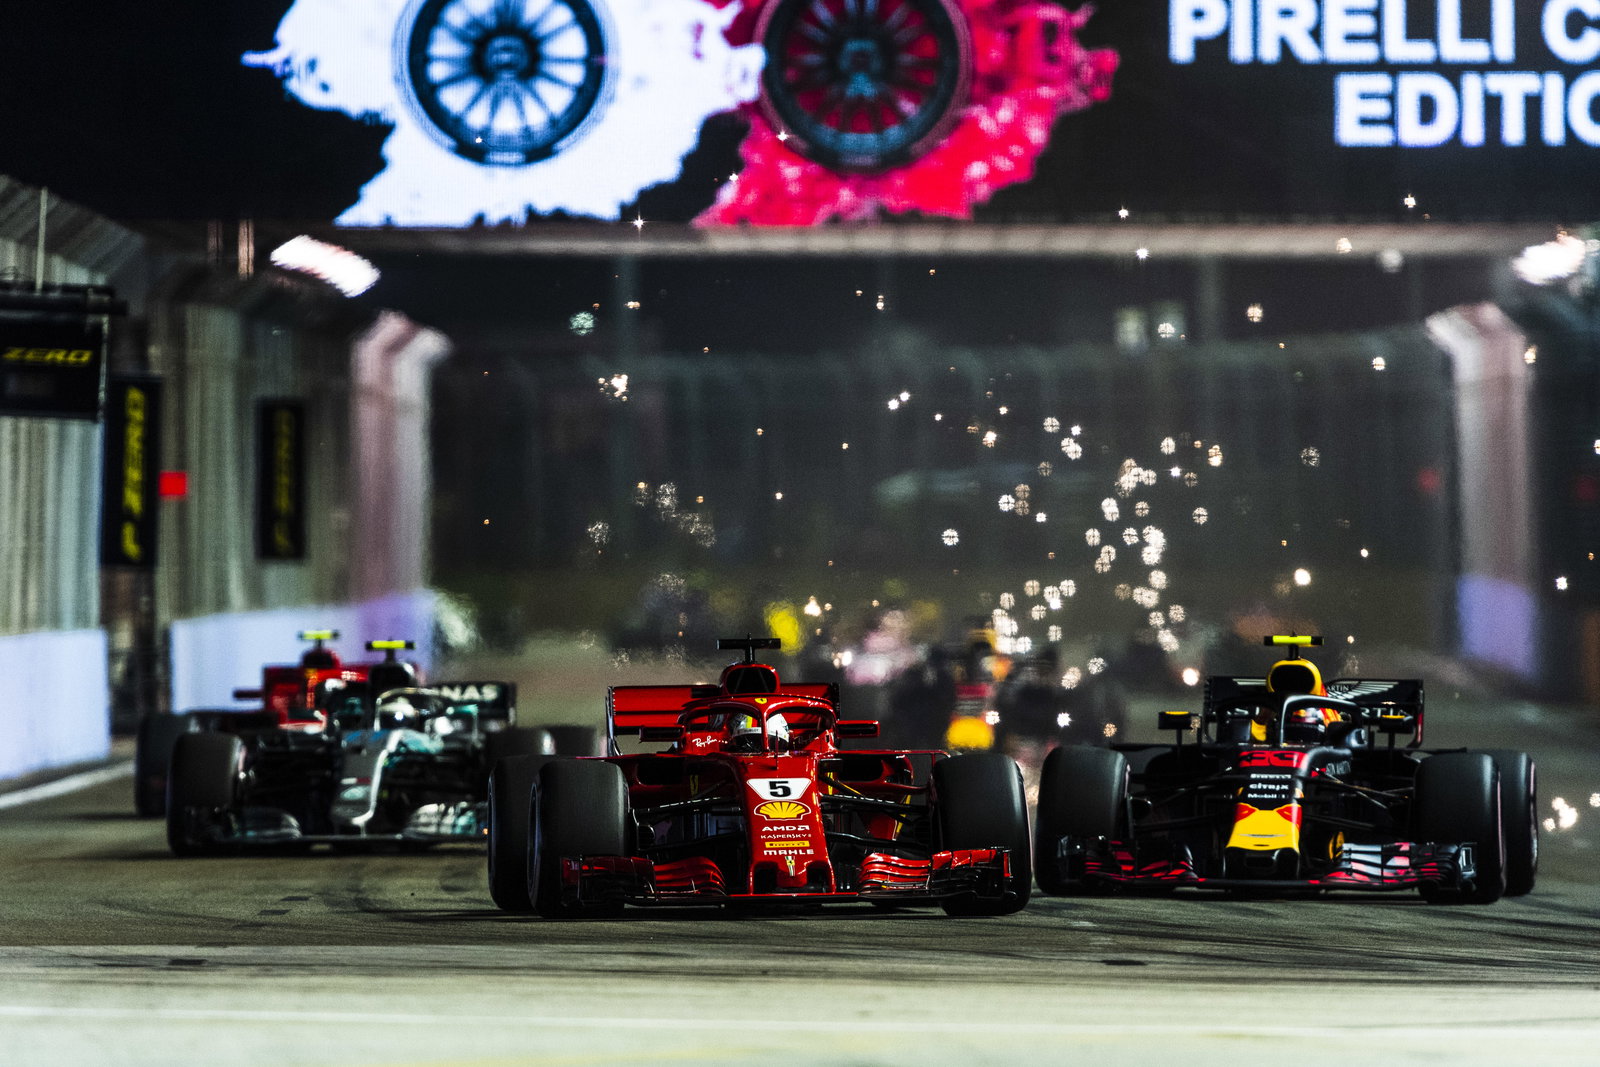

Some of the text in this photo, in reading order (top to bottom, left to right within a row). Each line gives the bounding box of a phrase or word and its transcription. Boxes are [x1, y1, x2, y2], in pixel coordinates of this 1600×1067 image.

[1168, 0, 1515, 64] PIRELLI
[3, 348, 92, 364] ZERO
[440, 684, 498, 701] NAS
[769, 781, 791, 797] 5
[763, 848, 815, 856] MAHLE
